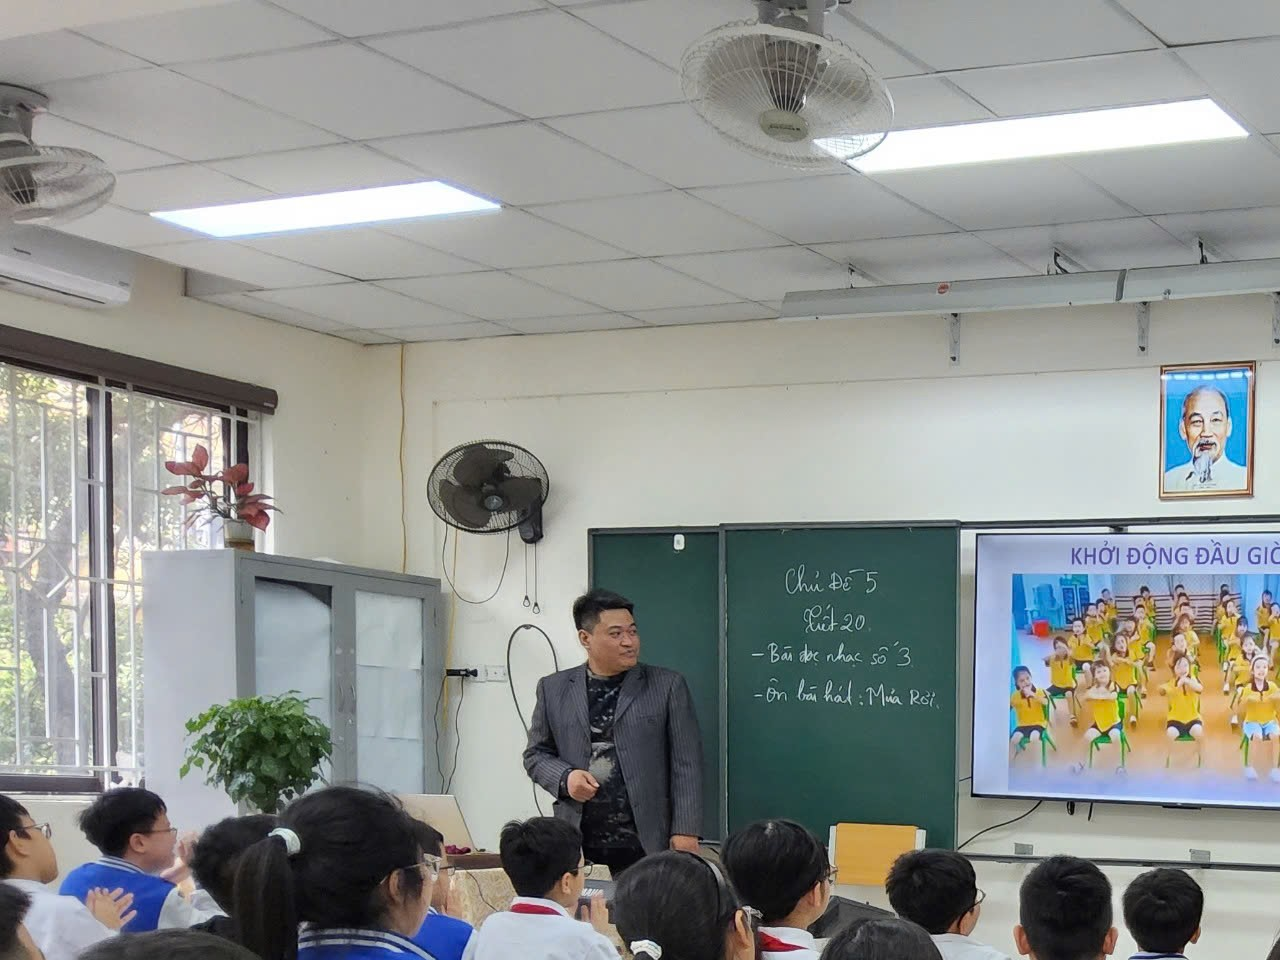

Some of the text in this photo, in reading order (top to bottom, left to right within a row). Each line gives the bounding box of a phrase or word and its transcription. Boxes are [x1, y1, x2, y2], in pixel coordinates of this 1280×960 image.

[1071, 540, 1120, 565] KHỞI
[1126, 542, 1189, 569] ĐỘNG
[1195, 539, 1240, 565] ĐẦU
[865, 571, 879, 594] 5
[826, 643, 863, 667] nhạc
